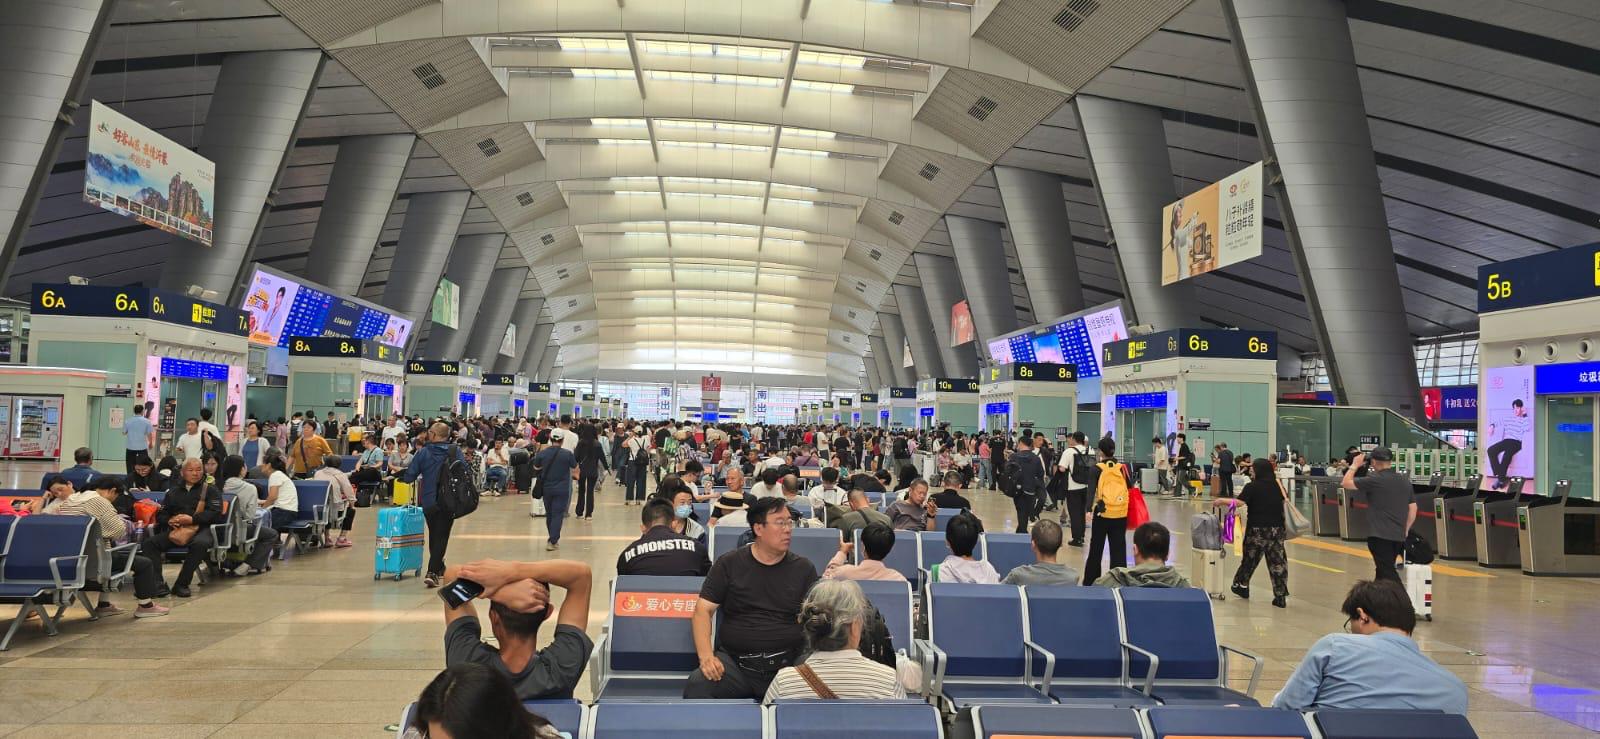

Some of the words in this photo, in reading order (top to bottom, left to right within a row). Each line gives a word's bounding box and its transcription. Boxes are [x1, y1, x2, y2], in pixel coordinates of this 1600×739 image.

[1487, 274, 1512, 300] 5B
[41, 290, 66, 309] 6A
[115, 293, 139, 312] 6A
[153, 296, 165, 315] 6A
[239, 315, 248, 331] 7A
[295, 340, 311, 352] 8A
[340, 342, 355, 354] 8A
[1168, 336, 1177, 351] 6B
[1189, 335, 1209, 351] 6B
[1249, 337, 1268, 353] 6B
[410, 363, 425, 371] 10A
[442, 364, 457, 373] 10A
[1020, 366, 1033, 377] 8B
[1058, 368, 1072, 379] 8B
[1579, 371, 1600, 383] 垃圾
[939, 381, 952, 389] 10B
[1464, 398, 1479, 409] 送父
[637, 539, 696, 555] MONSTER
[646, 598, 698, 612] 爱心专座
